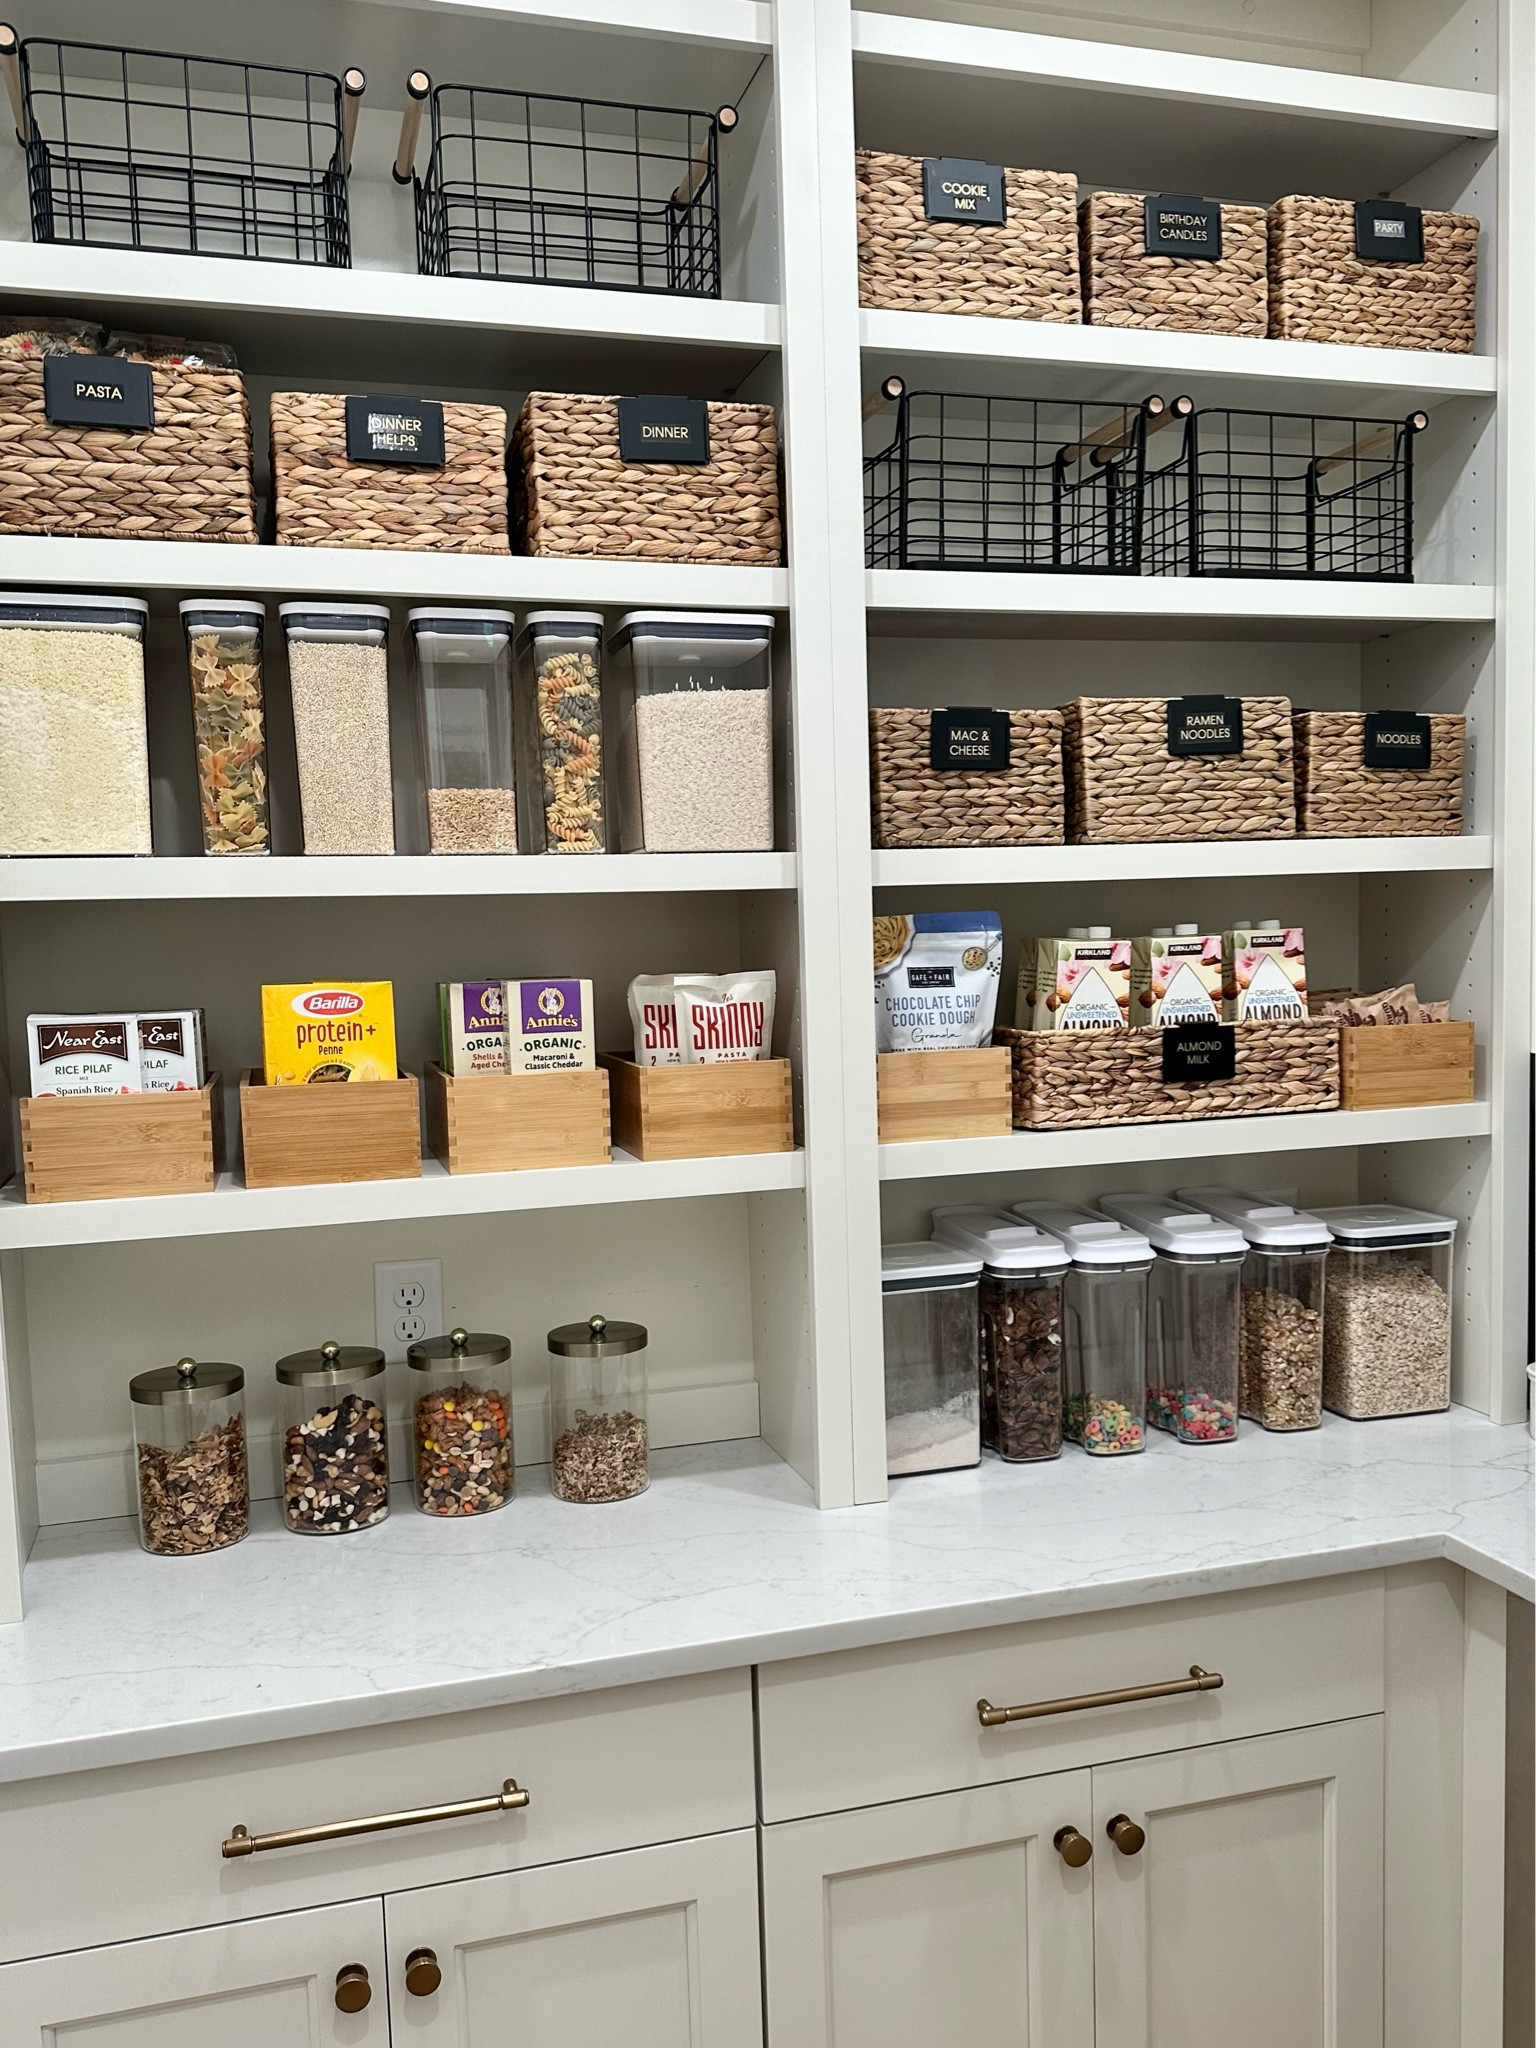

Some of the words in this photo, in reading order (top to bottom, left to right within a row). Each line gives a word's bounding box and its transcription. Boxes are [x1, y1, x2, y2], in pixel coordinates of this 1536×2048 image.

[942, 182, 987, 197] COOKIE
[954, 198, 976, 210] MIX
[1160, 213, 1207, 226] BIRTHDAY
[1375, 222, 1404, 234] PARTY
[1160, 228, 1208, 241] CANDLES
[76, 384, 123, 400] PASTA
[371, 416, 422, 432] DINNER
[642, 425, 689, 439] DINNER
[376, 432, 416, 447] HELPS
[1186, 714, 1225, 726] RAMEN
[951, 730, 979, 741] MAC
[981, 730, 990, 741] &
[1180, 727, 1231, 740] NOODLES
[1376, 733, 1421, 745] NOODLES
[949, 745, 990, 756] CHEESE
[1252, 936, 1285, 944] KIRKLAND
[1170, 944, 1203, 952] KIRKLAND
[934, 973, 951, 981] FAIR
[309, 996, 358, 1010] Barilla
[886, 995, 952, 1011] CHOCOLATE
[956, 994, 981, 1008] CHIP
[1170, 998, 1202, 1006] ORGANIC
[1248, 996, 1297, 1005] UNSWEETENED
[1075, 1003, 1109, 1011] ORGANIC
[1163, 1005, 1212, 1014] UNSWEETENED
[1245, 1004, 1302, 1020] ALMOND
[892, 1012, 936, 1027] COOKIE
[939, 1010, 976, 1025] DOUGH
[1066, 1011, 1118, 1019] UNSWEETENED
[526, 1014, 579, 1029] Annie's
[43, 1031, 91, 1050] Near
[91, 1029, 123, 1048] East
[148, 1026, 178, 1044] East
[911, 1027, 962, 1044] Granola
[318, 1045, 343, 1055] Penne
[524, 1037, 582, 1052] ORGANIC
[1176, 1041, 1222, 1052] ALMOND
[533, 1053, 567, 1061] Macaroni
[1187, 1055, 1210, 1065] MILK
[55, 1065, 79, 1075] RICE
[83, 1063, 113, 1073] PILAF
[144, 1059, 169, 1069] ILAF
[471, 1062, 490, 1070] Aged
[525, 1062, 550, 1070] Classic
[553, 1061, 583, 1069] Cheddar
[56, 1085, 92, 1096] Spanish
[94, 1085, 113, 1094] Rice
[151, 1081, 170, 1089] Rice
